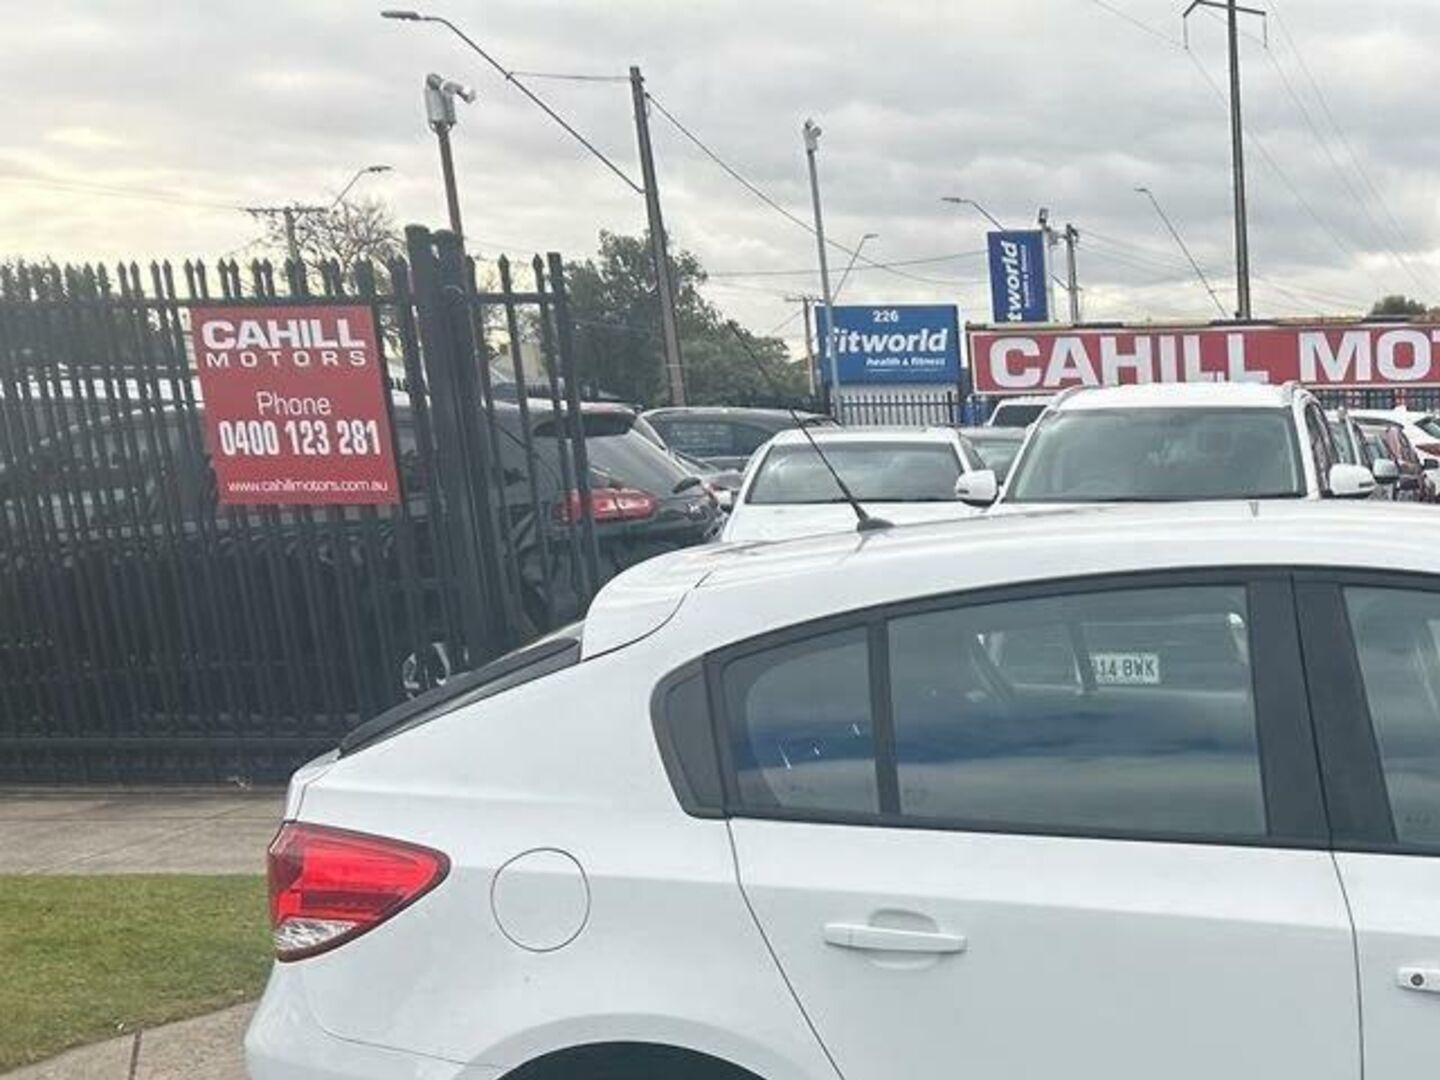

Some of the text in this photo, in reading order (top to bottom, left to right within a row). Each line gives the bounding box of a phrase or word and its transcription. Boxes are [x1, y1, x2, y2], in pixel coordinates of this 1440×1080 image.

[872, 309, 899, 322] 226
[202, 318, 366, 350] CAHILL
[206, 350, 367, 368] MOTORS
[989, 333, 1269, 388] CAHILL
[256, 391, 332, 416] Phone
[218, 419, 381, 456] 0400 123 281
